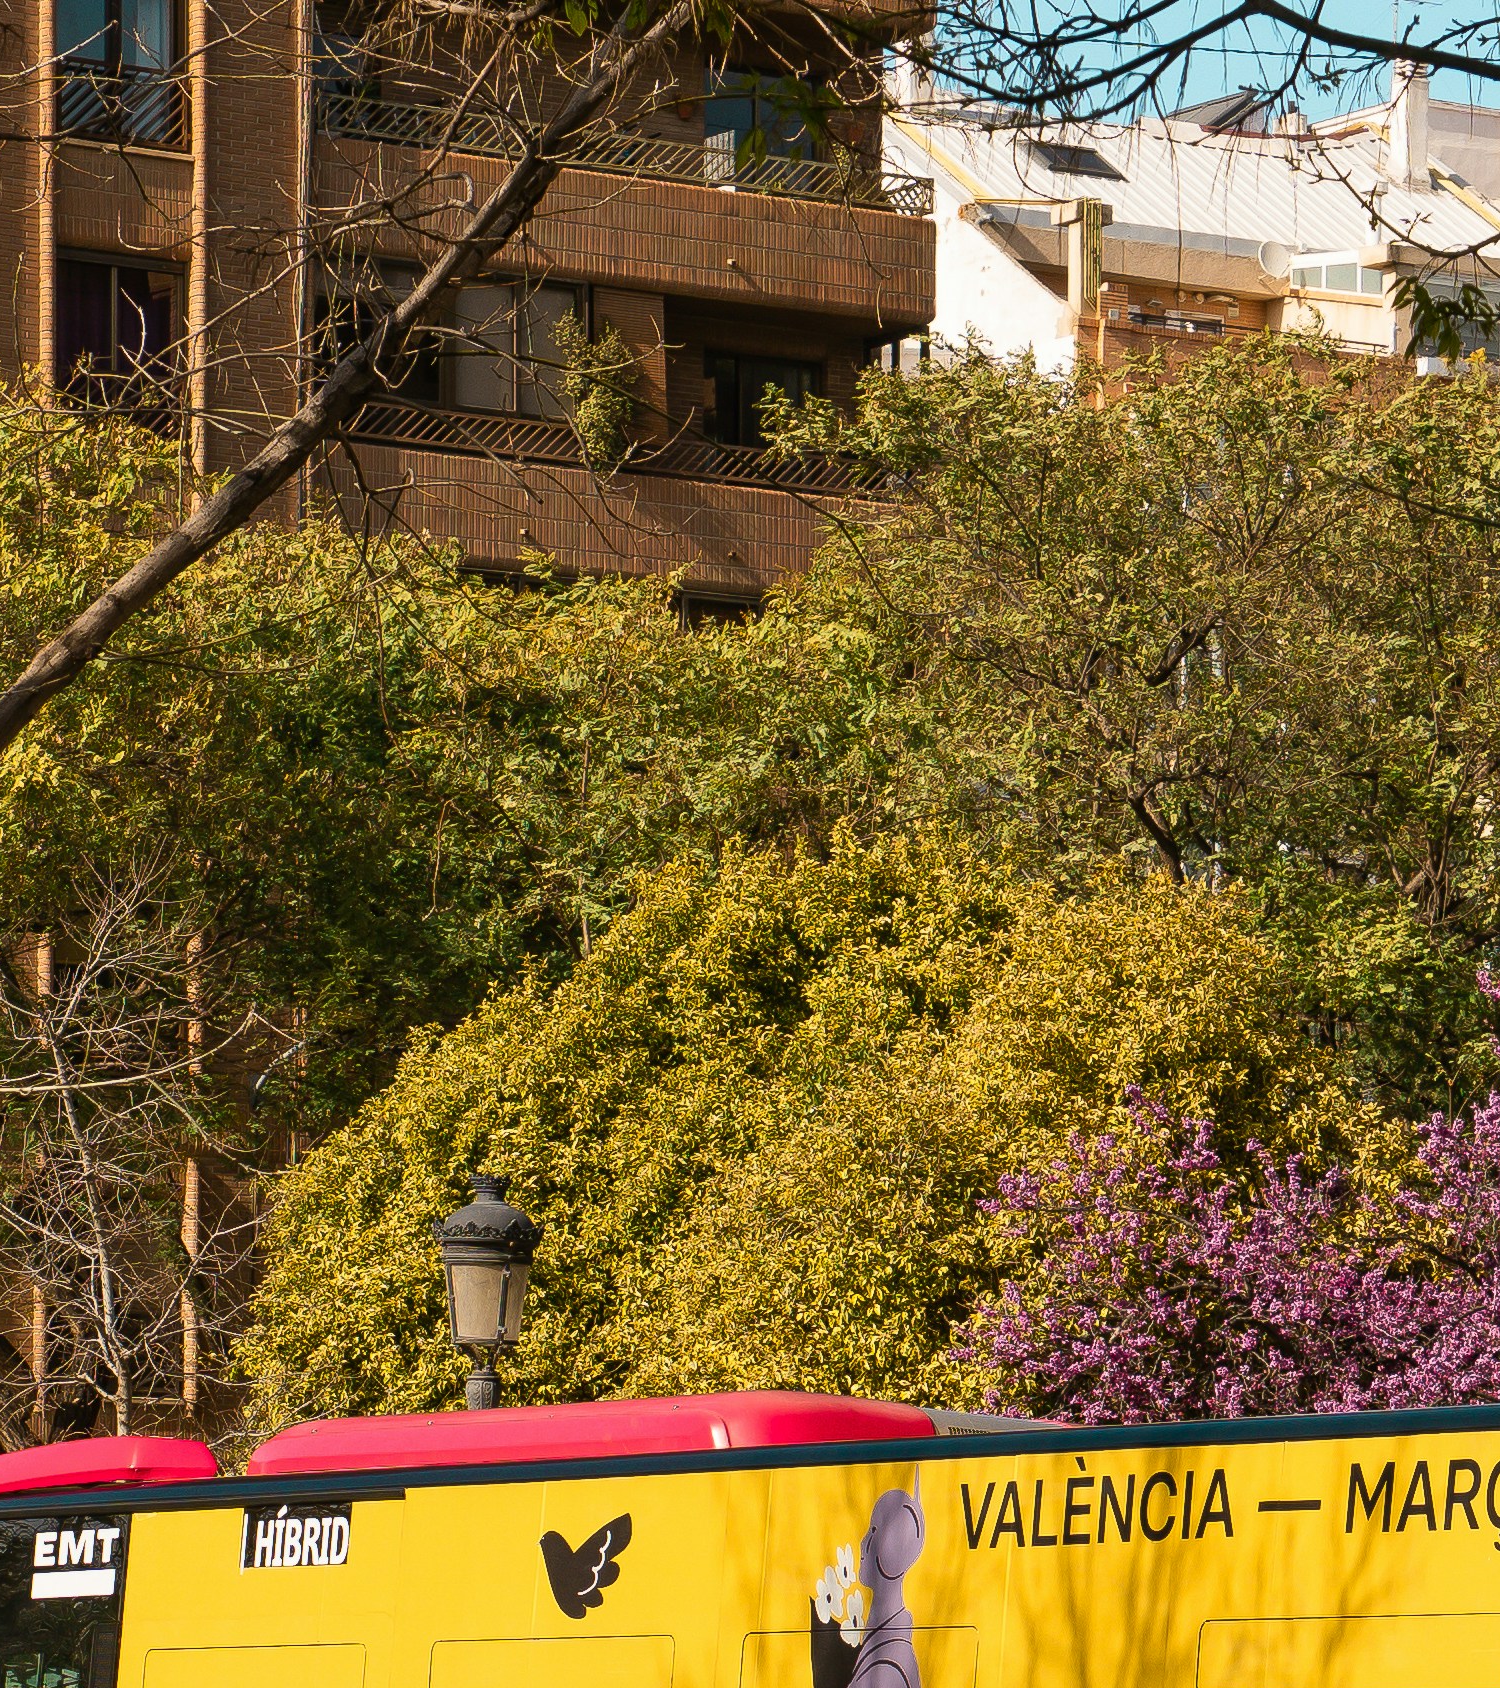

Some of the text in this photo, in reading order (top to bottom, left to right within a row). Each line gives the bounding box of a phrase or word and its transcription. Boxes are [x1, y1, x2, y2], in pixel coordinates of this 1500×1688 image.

[959, 1457, 1235, 1550] VALÈNCIA
[33, 1527, 120, 1567] EMT
[253, 1504, 350, 1568] HÍBRID
